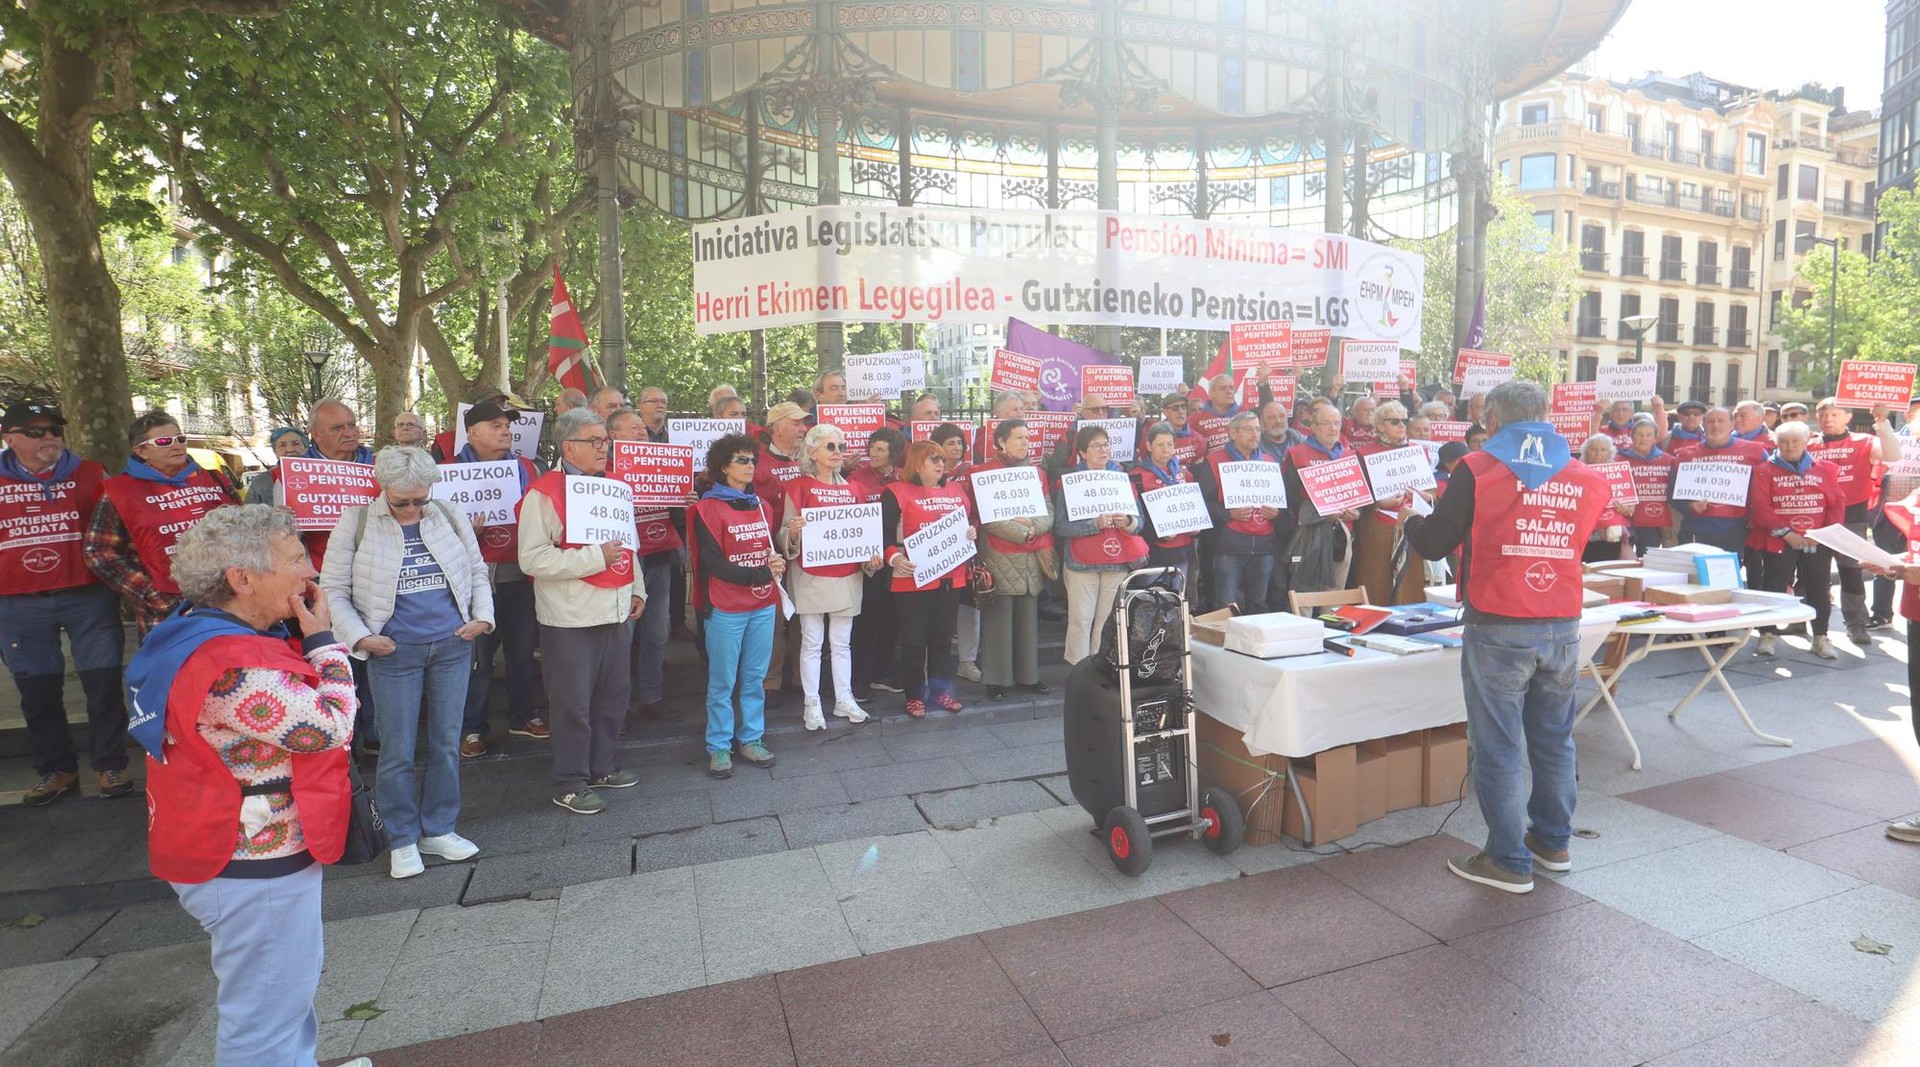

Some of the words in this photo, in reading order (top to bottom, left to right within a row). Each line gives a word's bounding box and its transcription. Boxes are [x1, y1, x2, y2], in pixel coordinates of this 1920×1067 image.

[694, 220, 798, 262] Iniciativa
[806, 212, 959, 256] Legislativa
[970, 214, 1082, 258] Popular
[1105, 217, 1197, 256] Pensión
[1313, 239, 1349, 271] SMI
[696, 286, 750, 323] Herri
[757, 281, 848, 316] Ekimen
[858, 277, 995, 320] Legegilea
[1022, 278, 1184, 317] Gutxieneko
[1360, 281, 1383, 301] EHPM
[1392, 288, 1415, 308] MPEH
[1235, 322, 1289, 332] GUTXIENEKO
[1244, 331, 1282, 339] PENTSIOA
[1238, 342, 1288, 351] GUTXIENEKO
[1347, 344, 1398, 353] GIPUZKOAN
[998, 352, 1041, 368] GUTXIENEKO
[1245, 350, 1281, 358] SOLDATA
[848, 357, 900, 366] GIPUZKOAN
[1004, 360, 1035, 373] PENTSIOA
[1142, 358, 1182, 366] GIPUZKOAN
[1357, 358, 1386, 366] 48.039
[1599, 366, 1655, 375] GIPUZKOAN
[1847, 363, 1914, 374] GUTXIENEKO
[862, 373, 891, 381] 48.039
[997, 370, 1037, 384] GUTXIENEKO
[1345, 371, 1399, 379] SINADURAK
[1857, 372, 1905, 381] PENTSIOA
[1001, 378, 1030, 389] SOLDATA
[1140, 383, 1178, 391] SINADURA
[1611, 378, 1642, 386] 48.039
[1846, 383, 1908, 393] GUTXIENEKO
[850, 387, 899, 397] SINADURAK
[1598, 391, 1653, 399] SINADURAK
[1854, 391, 1898, 400] SOLDATA
[823, 407, 884, 416] GUTXIENEKO
[834, 416, 878, 424] PENTSIOA
[672, 422, 742, 432] GIPUZKOAN
[690, 440, 714, 449] 48.0
[621, 445, 692, 457] GUTXIENEKO
[1368, 447, 1423, 467] GIPUZKOAN
[634, 457, 684, 467] PENTSIOA
[772, 466, 801, 475] GUTXIE
[1222, 464, 1279, 474] GIPUZKOAN
[1303, 459, 1358, 479] GUTXIENEKO
[1386, 464, 1416, 478] 48.039
[1682, 464, 1748, 474] GIPUZKOAN
[309, 475, 373, 488] PENTSIOA
[624, 474, 690, 483] GUTXIENEKO
[977, 471, 1036, 486] GIPUZKOA
[1065, 472, 1127, 486] GIPUZKOAN
[1315, 469, 1354, 484] PENTSIOA
[1694, 477, 1730, 486] 48.039
[635, 484, 681, 494] SOLDATA
[1239, 479, 1270, 488] 48.039
[1314, 480, 1364, 499] GUTXIENEKO
[1376, 476, 1434, 496] SINADURAK
[1516, 480, 1583, 497] PNSIÓN
[146, 486, 223, 504] GUTXIENEKO
[298, 494, 374, 504] GUTXIENEK
[450, 489, 502, 504] 48.039
[993, 488, 1030, 500] 48.039
[1084, 488, 1119, 498] 48.039
[1146, 486, 1199, 502] GIPUZKOAN
[1227, 494, 1284, 504] SINADURAK
[1324, 489, 1359, 504] SOLDATA
[1676, 489, 1744, 502] SINADURAK
[159, 494, 221, 510] PENTSIOA
[1166, 501, 1195, 514] 48.039
[590, 506, 630, 523] 48.039
[806, 506, 879, 522] GIPUZKOAN
[994, 504, 1036, 518] FIRMAS
[1071, 503, 1135, 517] SINADURAK
[9, 522, 69, 537] SOLDATA
[908, 509, 966, 550] GIPUZKOAN
[1158, 516, 1211, 533] SINADURAK
[1516, 519, 1575, 534] SALARIO
[586, 528, 632, 545] FIRMAS
[735, 530, 769, 541] PENTSIO
[823, 527, 863, 540] 48.039
[1520, 530, 1569, 547] MÍNMO
[927, 534, 958, 558] 48.039
[806, 545, 880, 562] SINADURAK
[415, 556, 431, 564] ez
[917, 541, 975, 582] SINADURAK
[401, 568, 418, 577] da
[400, 576, 442, 589] ilegala
